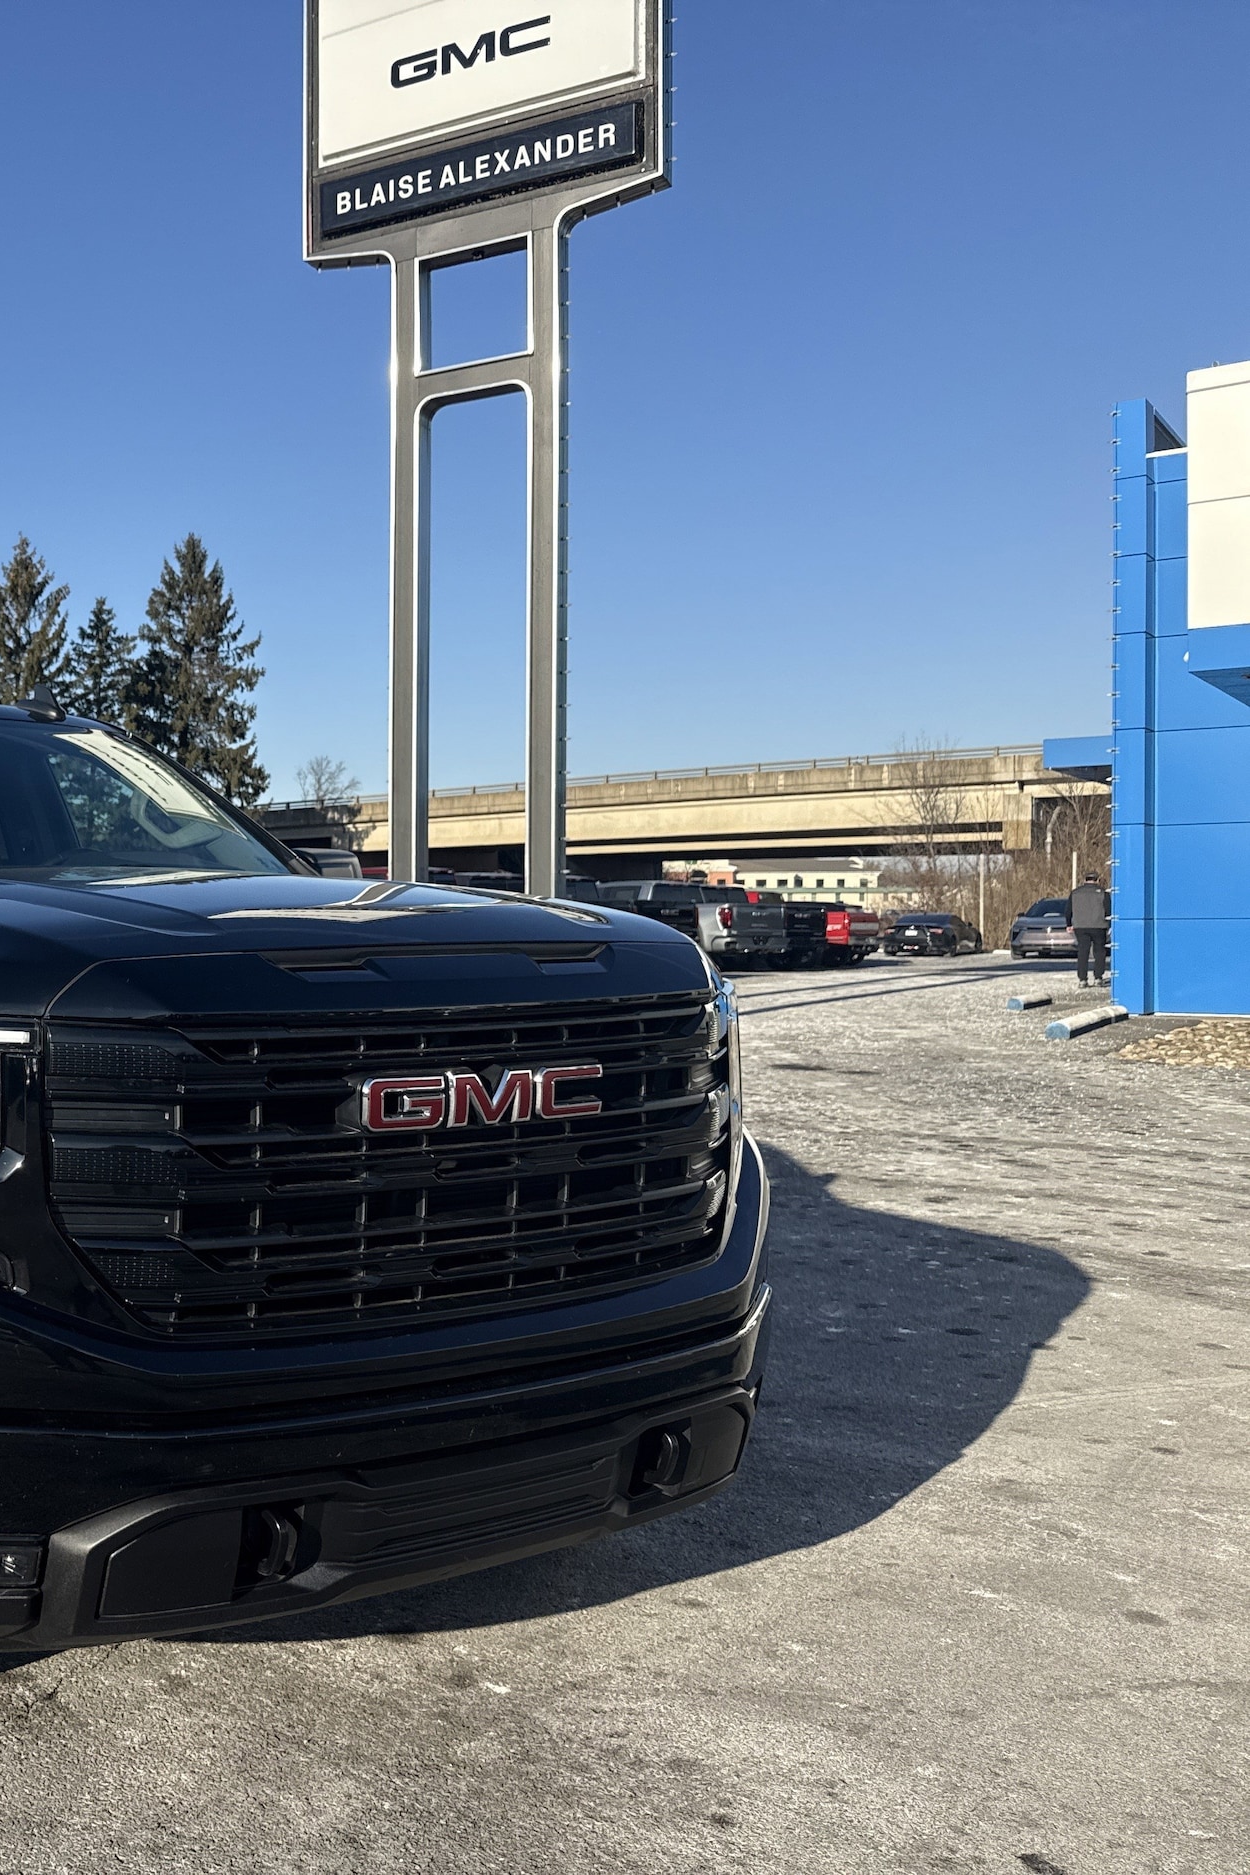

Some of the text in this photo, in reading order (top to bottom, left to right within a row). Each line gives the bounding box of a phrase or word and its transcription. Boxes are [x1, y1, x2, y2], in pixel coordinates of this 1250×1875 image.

[390, 15, 551, 89] GMC
[336, 122, 617, 216] BLAISE ALEXANDER
[360, 1064, 603, 1131] GMC
